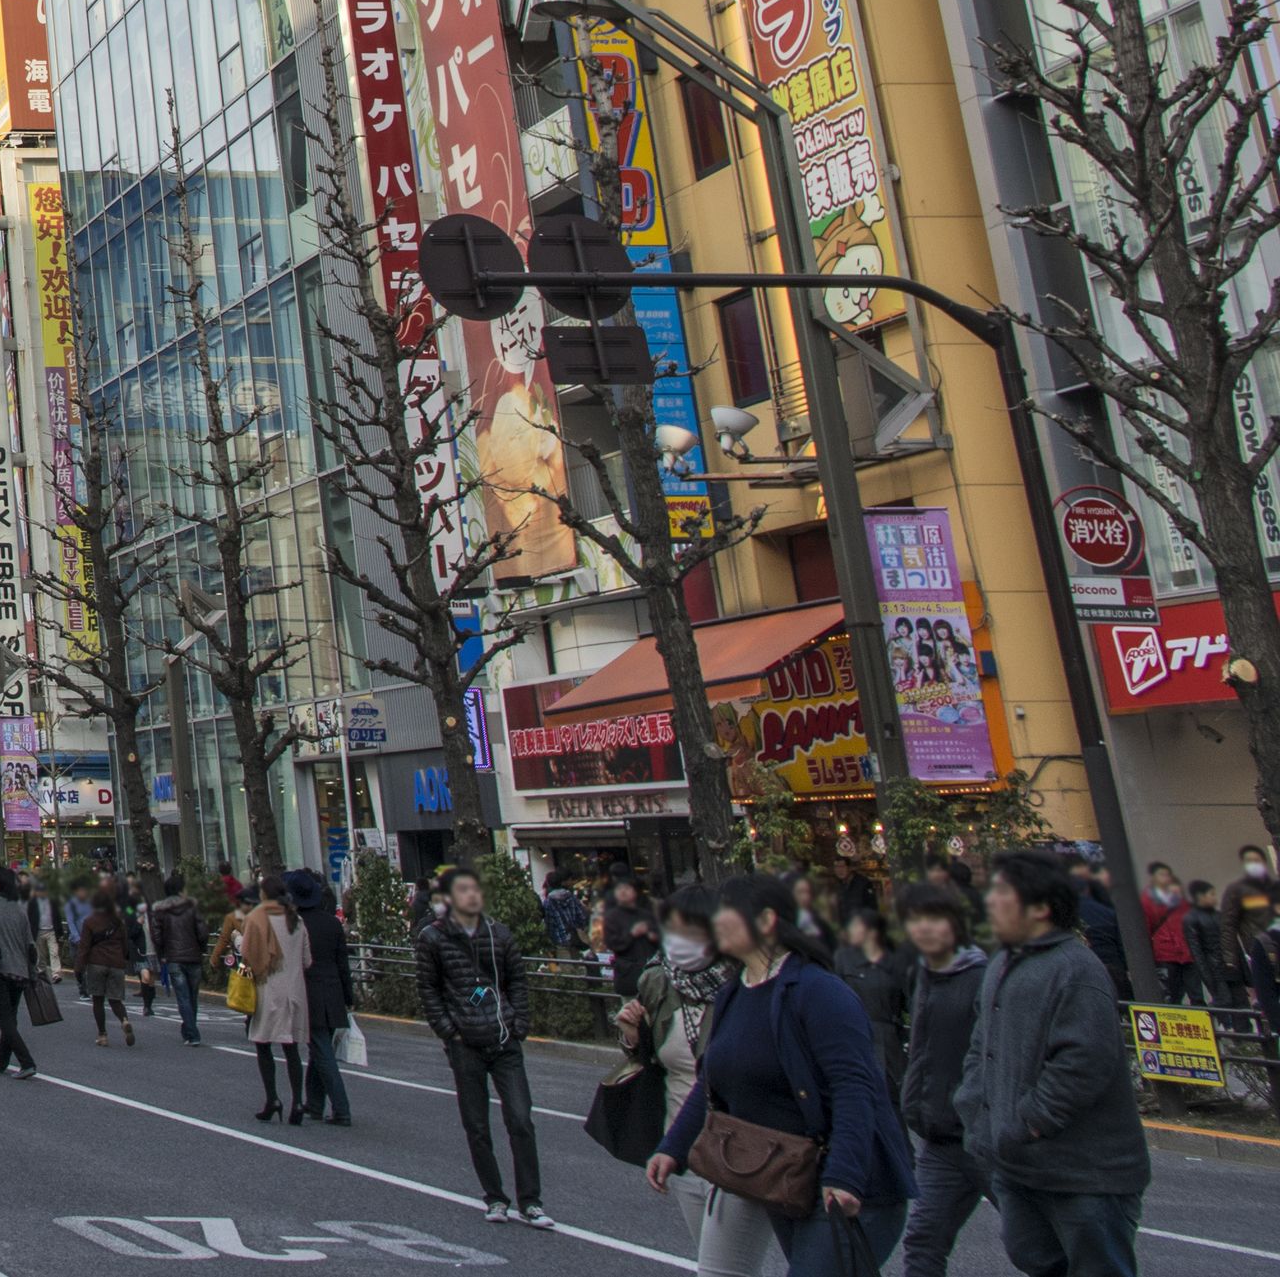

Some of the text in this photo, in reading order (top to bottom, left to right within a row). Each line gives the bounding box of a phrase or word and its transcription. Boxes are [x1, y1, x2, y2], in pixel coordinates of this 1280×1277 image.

[436, 46, 486, 211] パセ
[1069, 519, 1126, 547] 消火栓
[884, 569, 951, 589] まつり
[1070, 583, 1118, 596] docomo
[768, 649, 834, 702] DVD
[350, 729, 385, 742] のりば
[806, 755, 861, 785] ラムタラ
